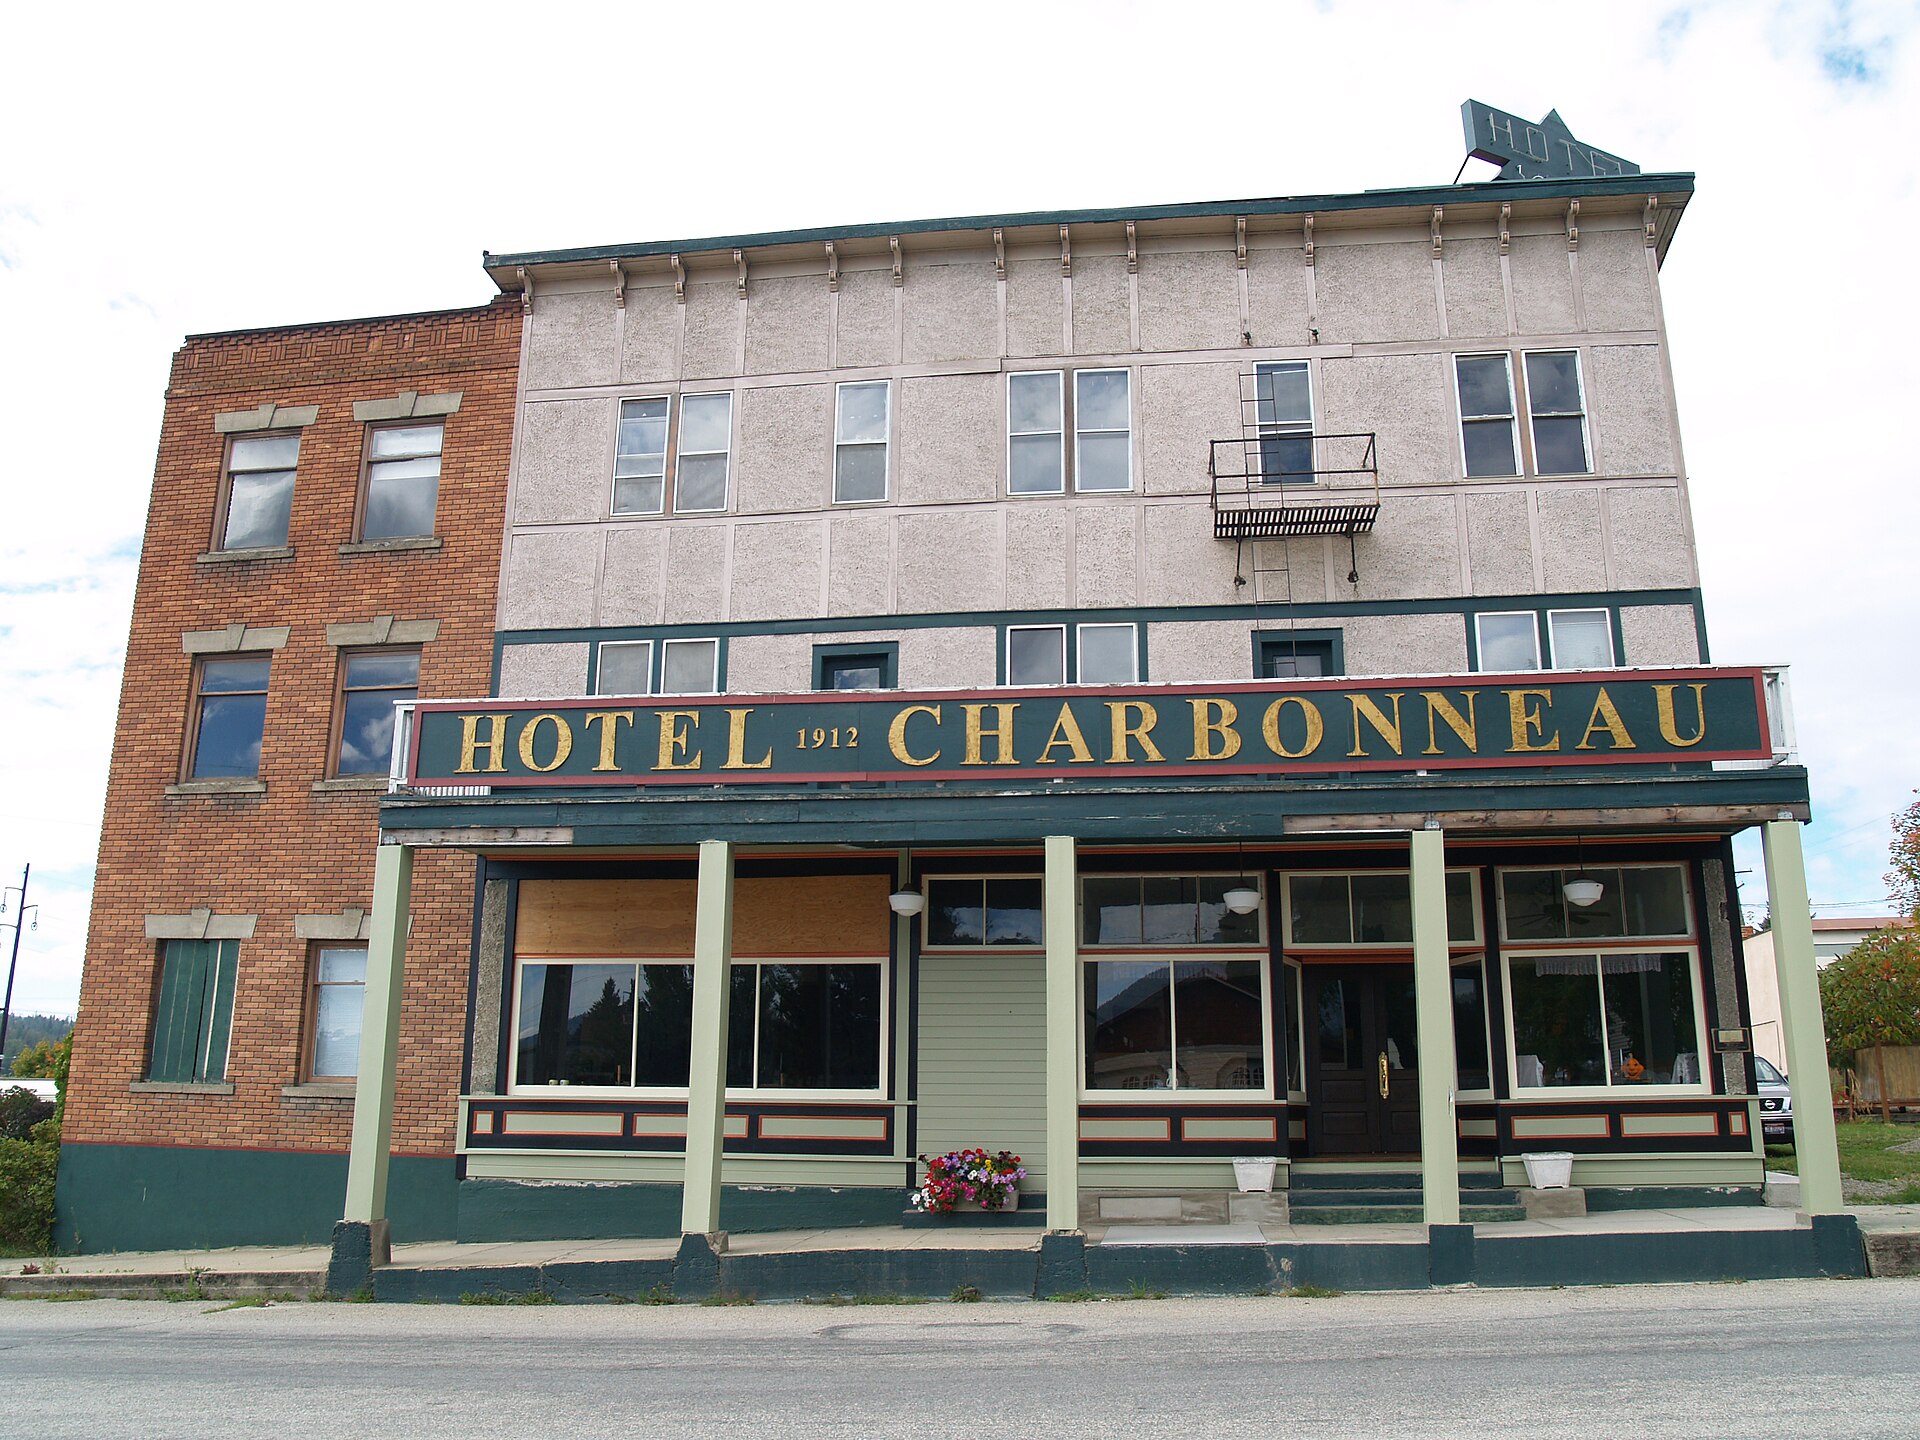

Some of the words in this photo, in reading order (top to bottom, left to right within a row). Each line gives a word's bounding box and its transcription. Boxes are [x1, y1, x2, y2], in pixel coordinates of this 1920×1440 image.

[453, 708, 773, 774] HOTEL
[796, 726, 859, 749] 1912
[887, 683, 1707, 767] CHARBONNEAU
